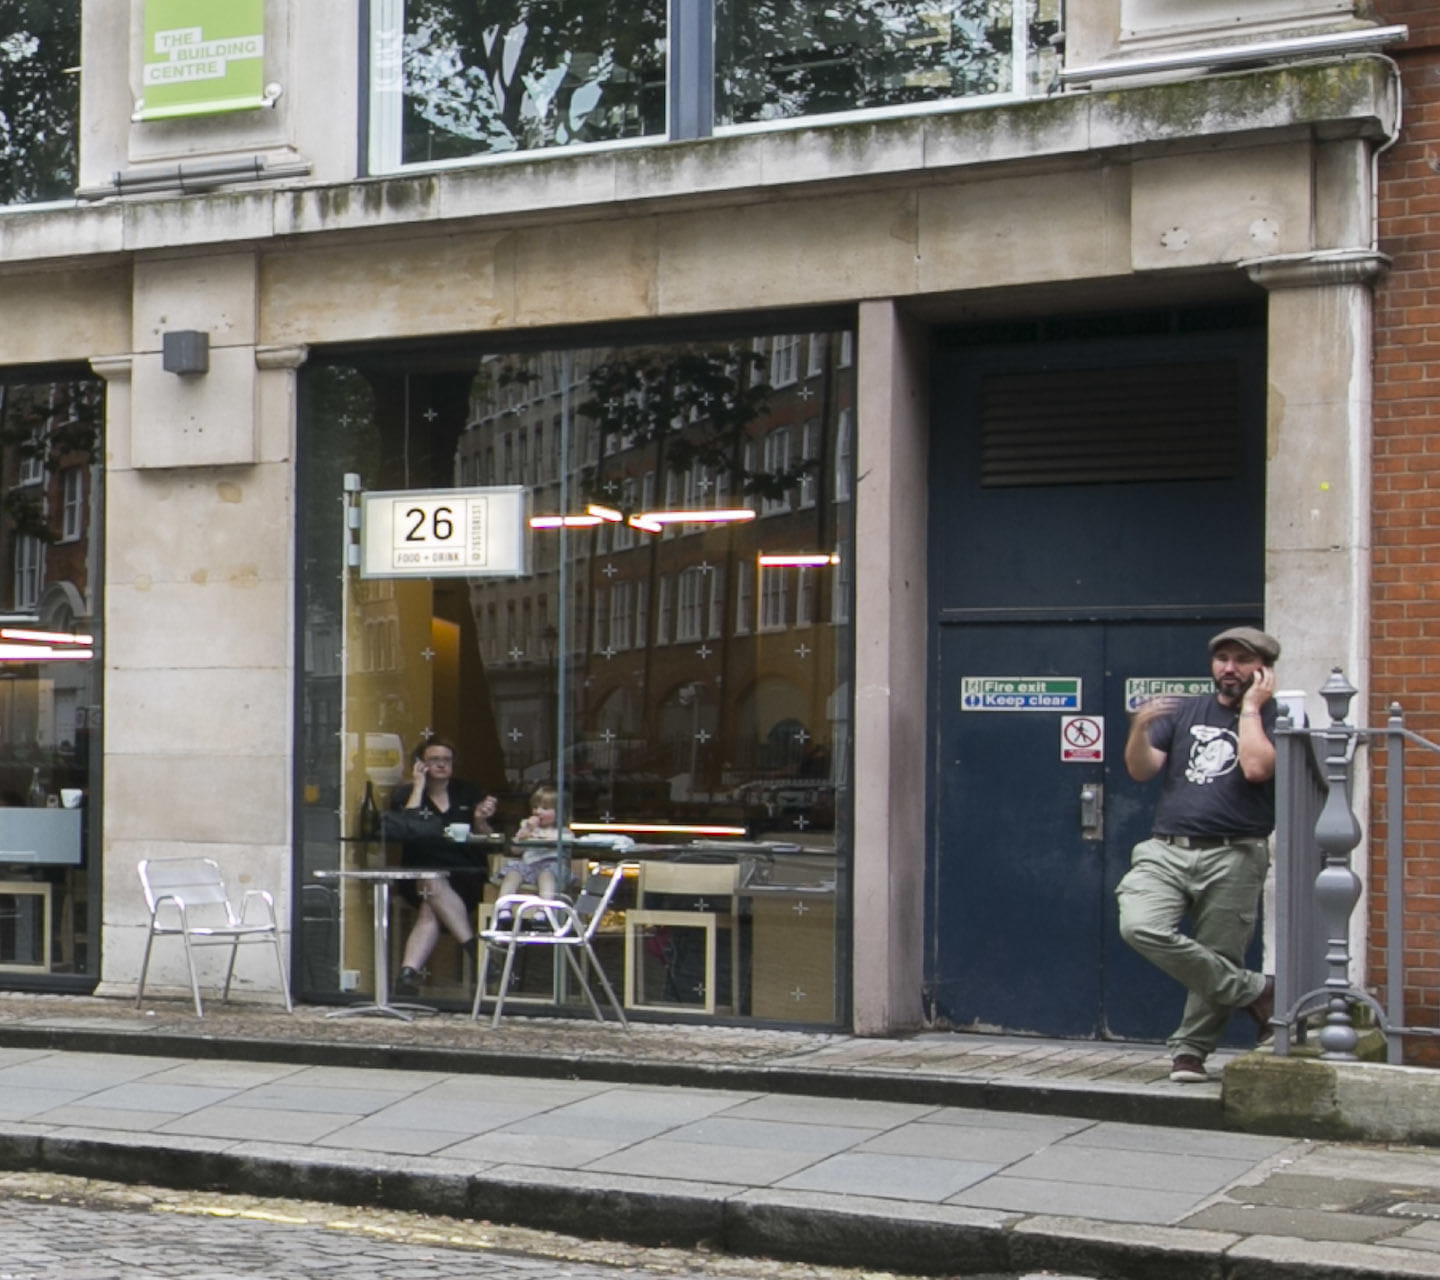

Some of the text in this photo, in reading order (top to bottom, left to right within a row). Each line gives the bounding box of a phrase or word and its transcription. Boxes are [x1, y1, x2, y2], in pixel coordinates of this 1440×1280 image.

[160, 32, 194, 47] THE
[177, 41, 257, 60] BUILDING
[150, 61, 218, 80] CENTRE
[405, 506, 454, 541] 26
[397, 552, 421, 563] FOOD
[432, 551, 460, 563] DRINK
[985, 681, 1047, 693] Fire exit
[1151, 682, 1215, 694] Fire exi
[986, 695, 1068, 707] Keep clear
